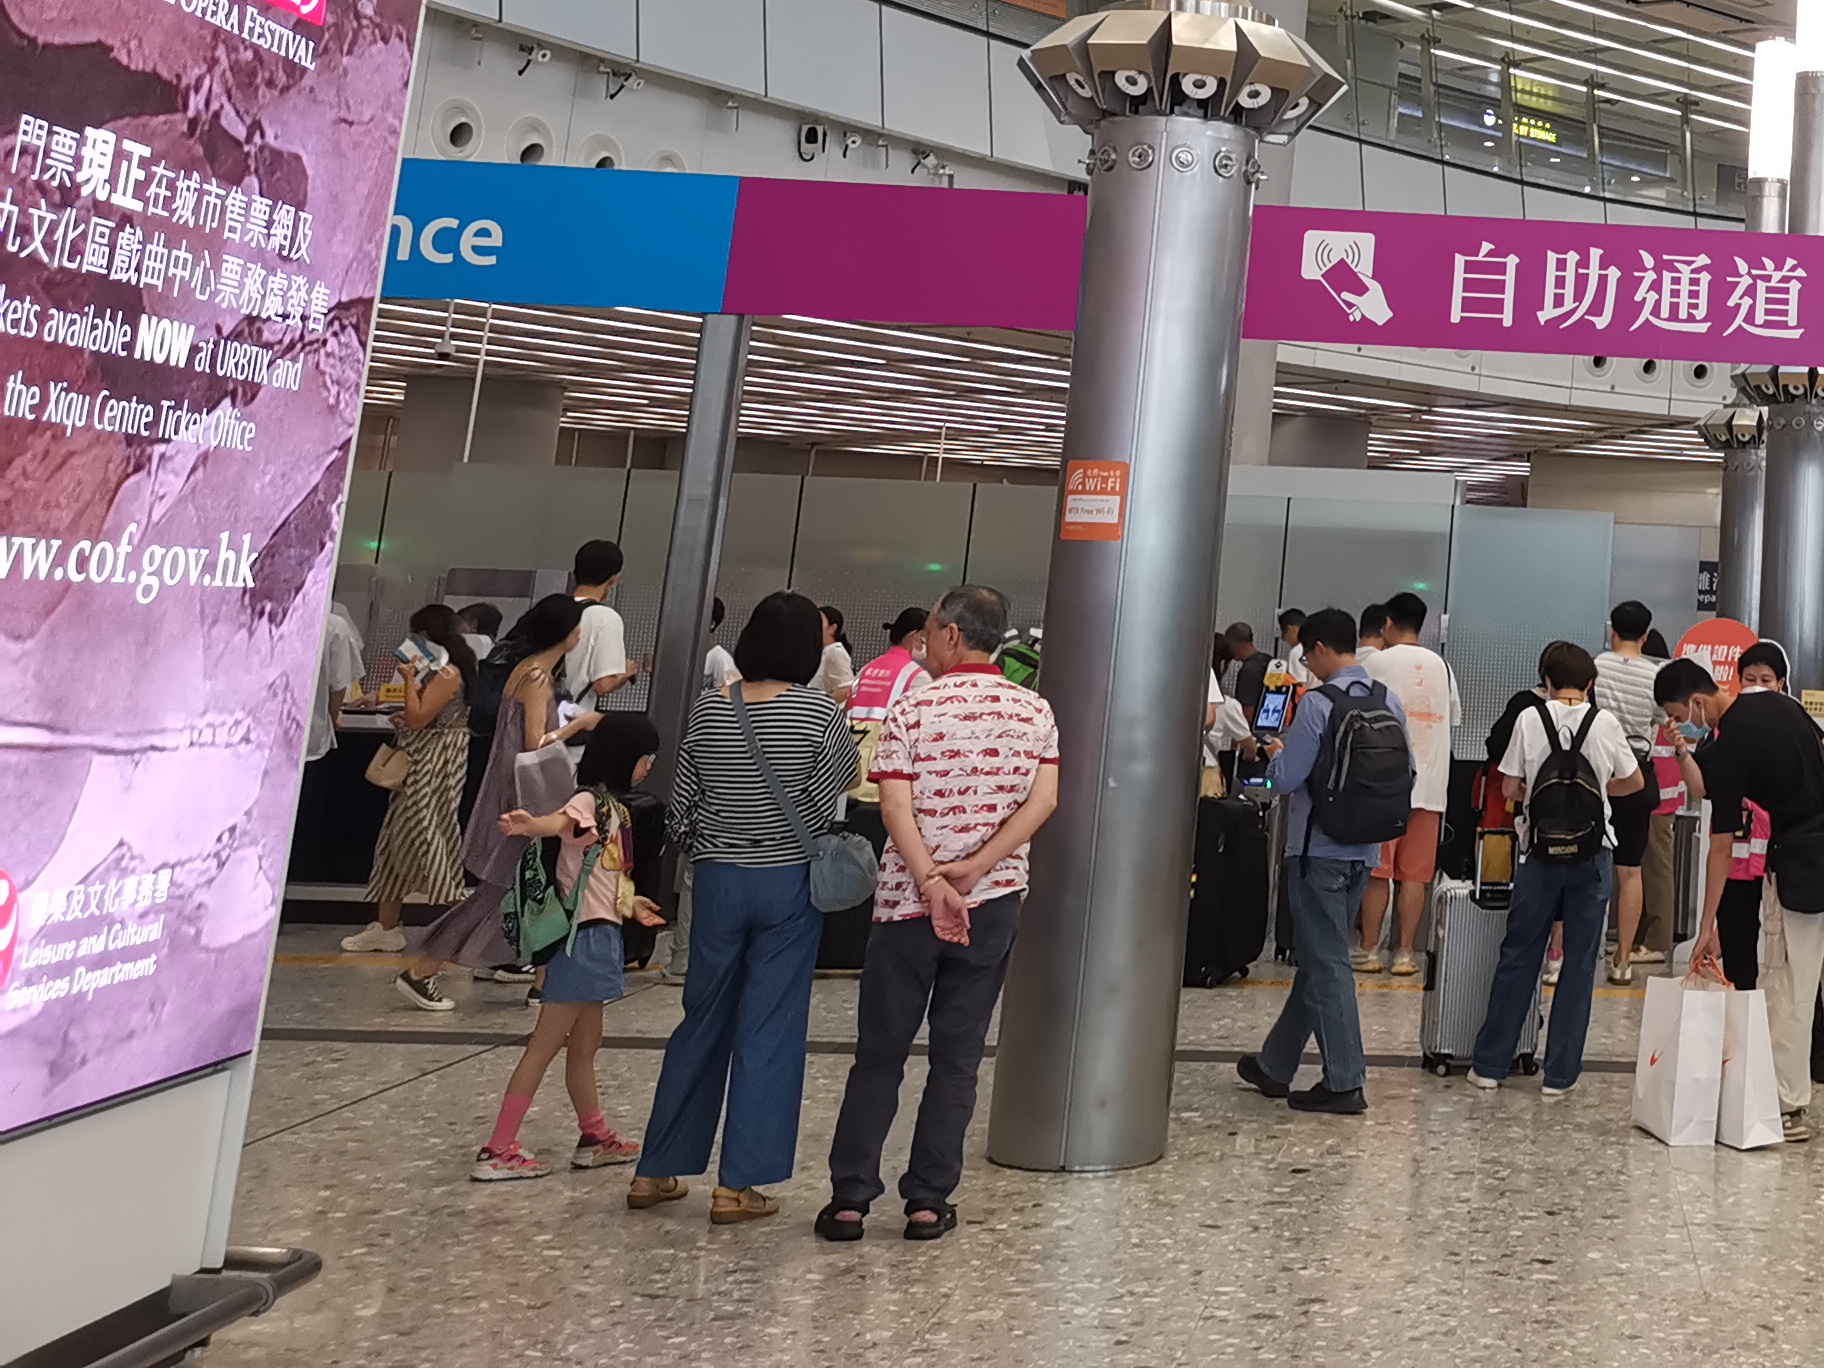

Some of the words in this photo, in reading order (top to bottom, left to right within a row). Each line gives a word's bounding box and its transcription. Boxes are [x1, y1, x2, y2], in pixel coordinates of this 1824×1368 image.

[241, 3, 317, 71] FESTIVAL
[1449, 240, 1808, 340] 自助通道
[43, 303, 132, 357] available
[134, 313, 195, 369] NOW
[194, 336, 215, 374] at
[216, 338, 273, 385] URBTIX
[272, 352, 304, 392] and
[4, 370, 41, 421] the
[43, 380, 91, 437] Xiqu
[93, 389, 154, 437] Centre
[158, 399, 209, 444] Ticket
[210, 407, 256, 452] Office
[1085, 476, 1120, 492] Wi-Fi
[21, 938, 77, 971] Leisure
[76, 925, 109, 958] and
[108, 913, 165, 951] Cultural
[72, 952, 158, 1002] Department
